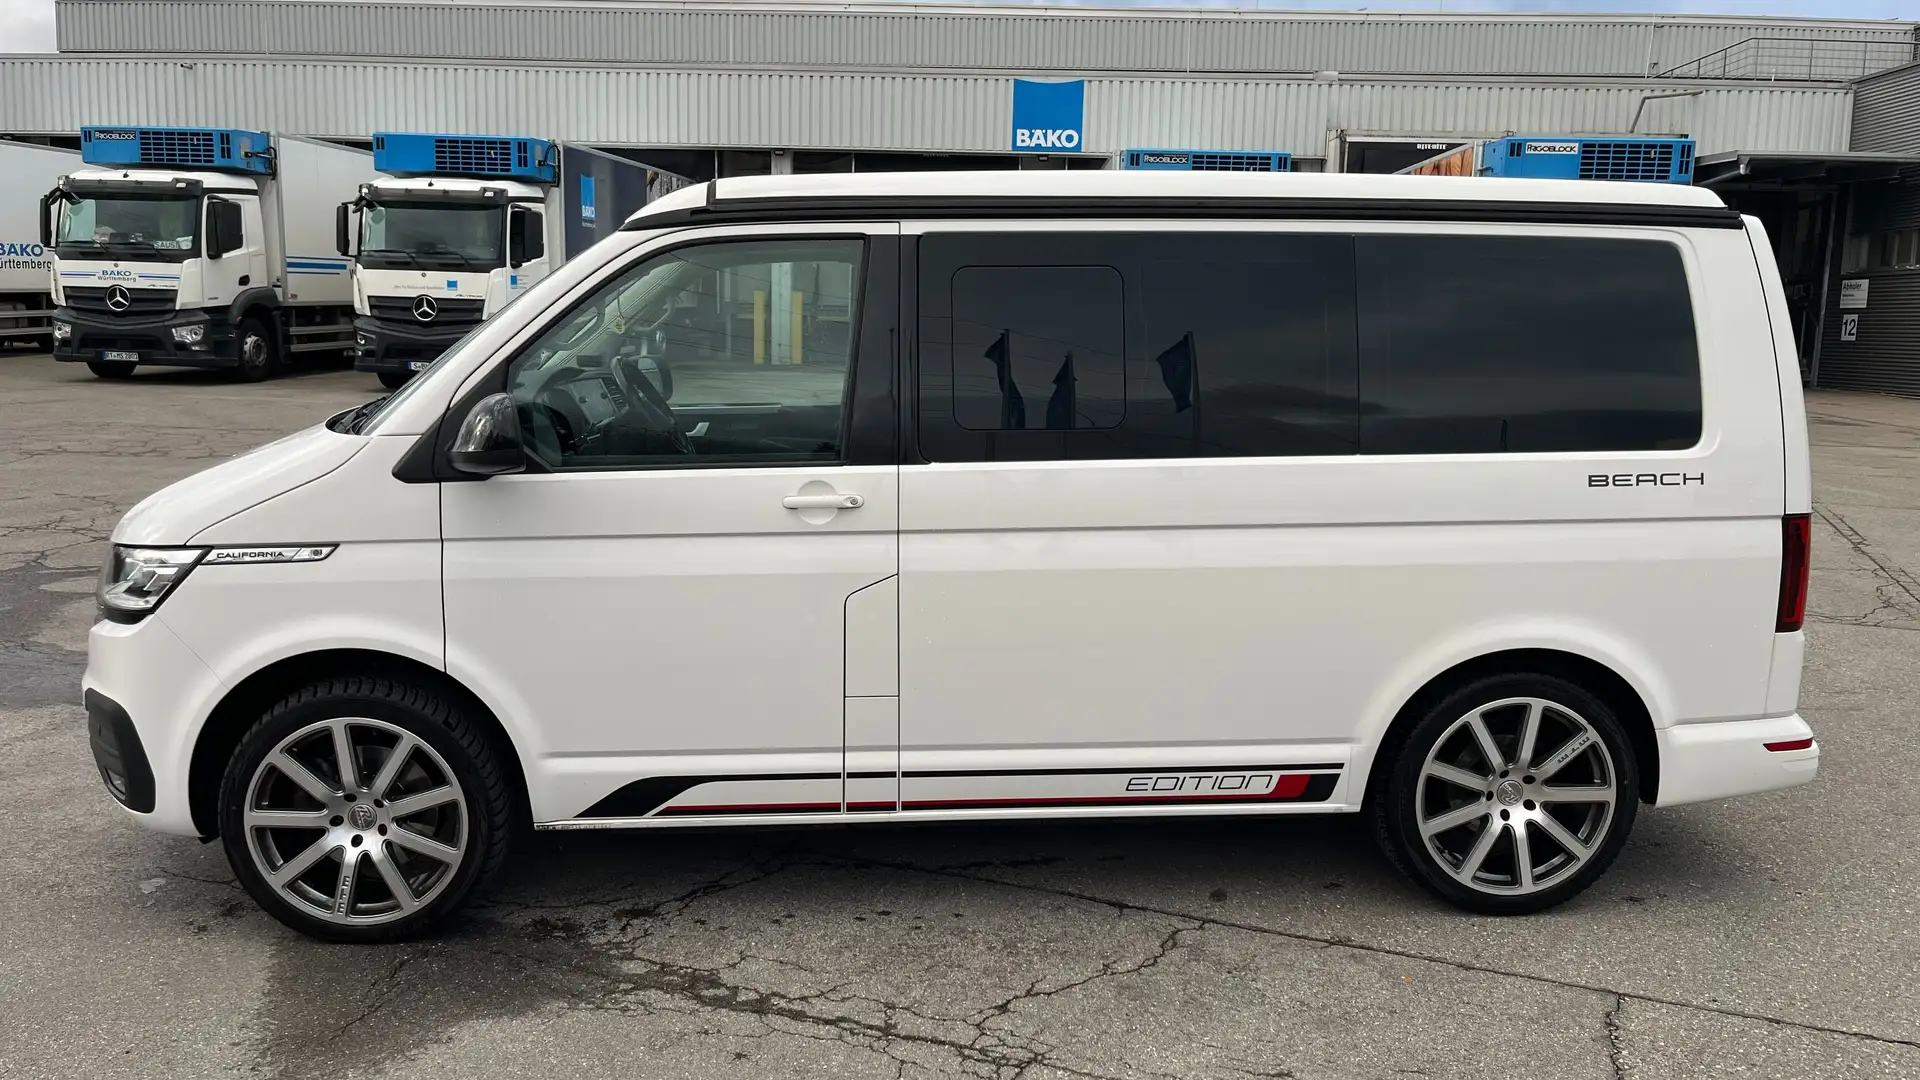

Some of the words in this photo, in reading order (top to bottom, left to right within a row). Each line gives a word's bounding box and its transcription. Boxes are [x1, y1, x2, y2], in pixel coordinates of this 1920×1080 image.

[1016, 128, 1079, 149] BÄKO
[0, 242, 44, 257] BÄKO
[1843, 318, 1857, 337] 12
[1587, 472, 1704, 488] BEACH
[216, 551, 285, 559] CALIFORNIA
[1125, 774, 1273, 792] EDITION
